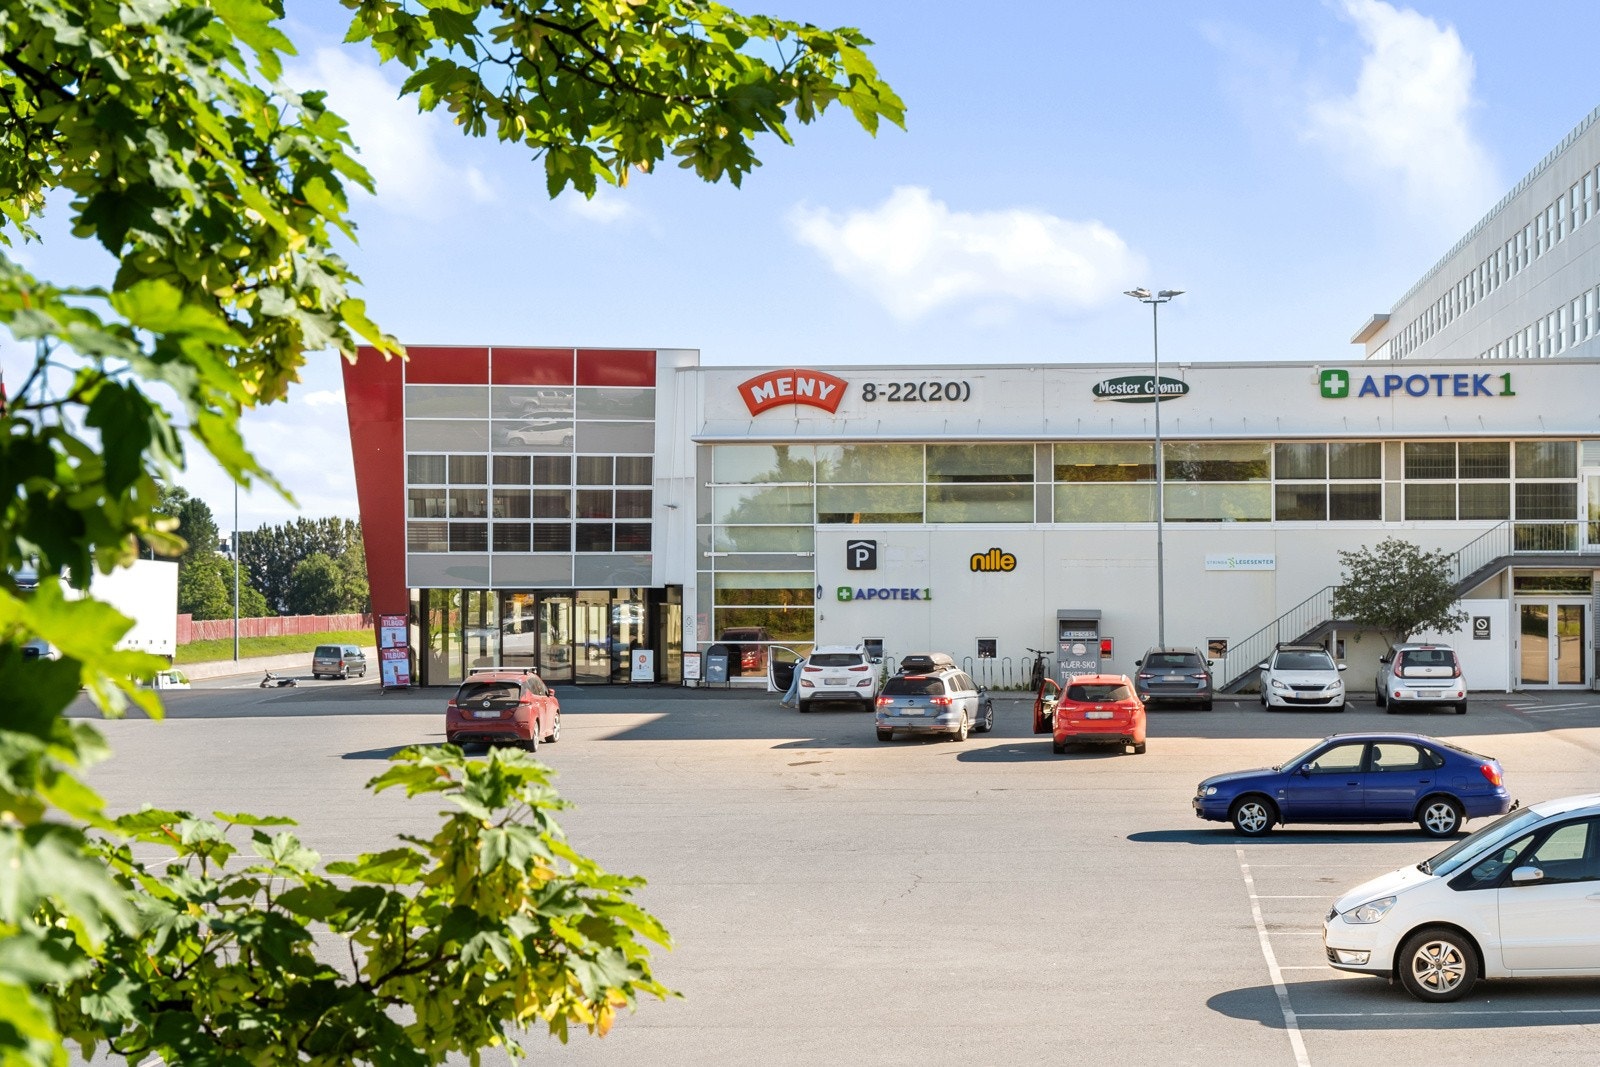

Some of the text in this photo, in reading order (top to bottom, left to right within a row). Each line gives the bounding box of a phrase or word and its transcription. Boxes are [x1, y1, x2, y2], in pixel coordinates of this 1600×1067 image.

[750, 377, 836, 404] MENY
[861, 381, 971, 402] 8-22(20)
[1098, 381, 1140, 394] Mester
[855, 549, 870, 568] P
[971, 548, 1017, 572] nille
